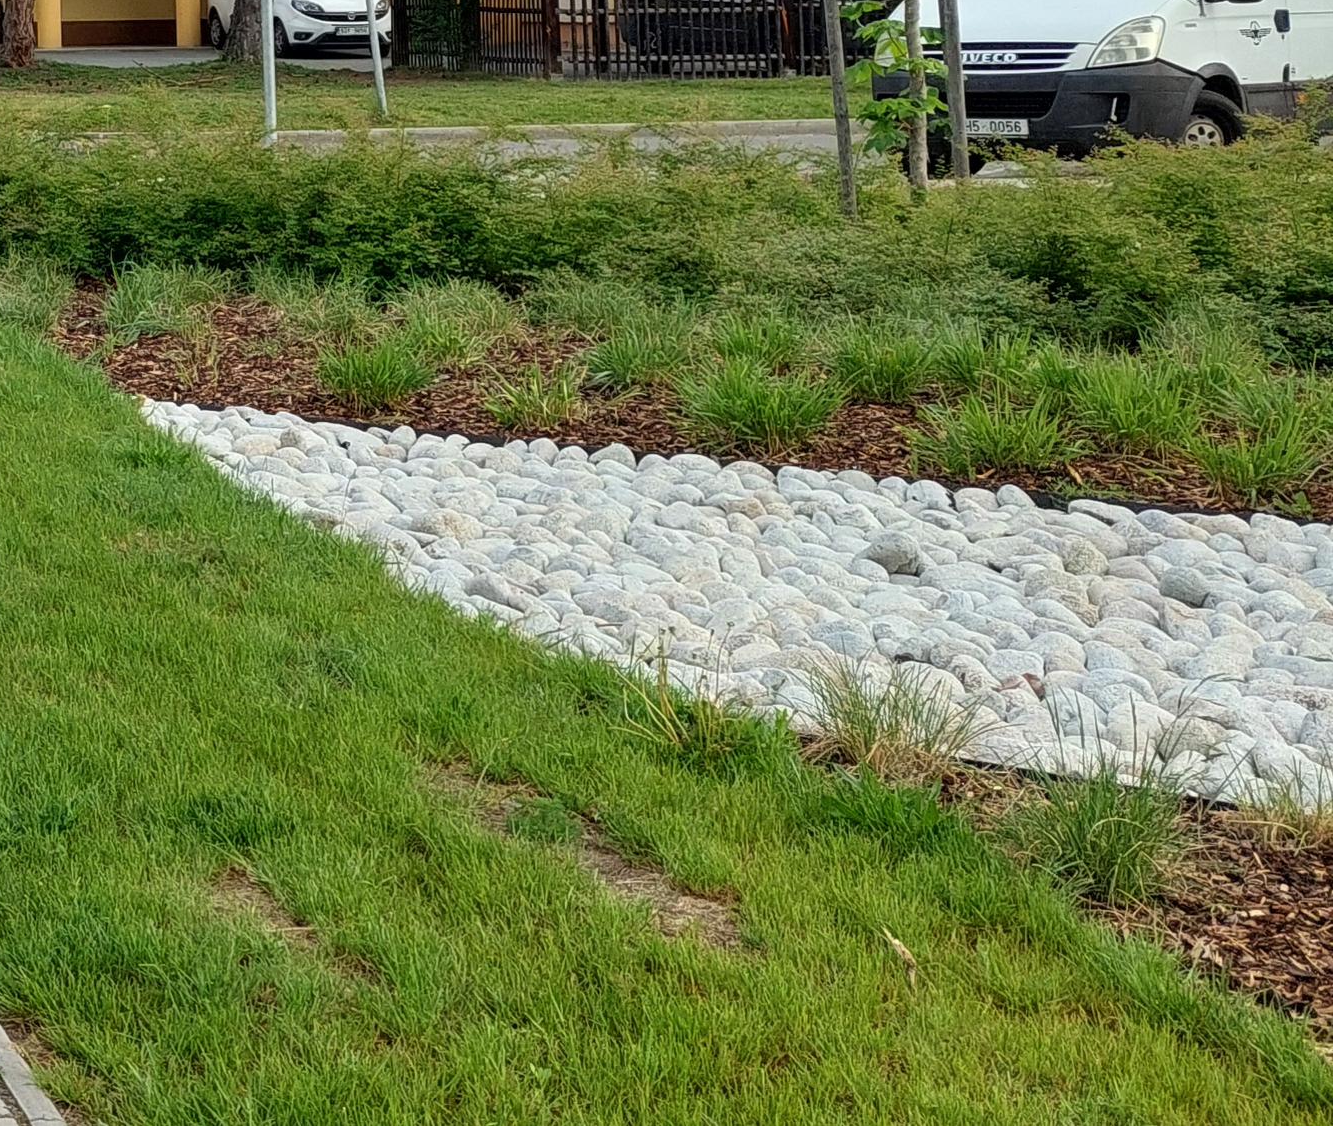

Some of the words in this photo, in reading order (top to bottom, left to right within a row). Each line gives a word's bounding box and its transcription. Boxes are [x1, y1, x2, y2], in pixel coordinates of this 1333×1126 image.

[962, 53, 1017, 63] IVECO
[966, 120, 980, 132] H5
[989, 120, 1022, 133] 0056
